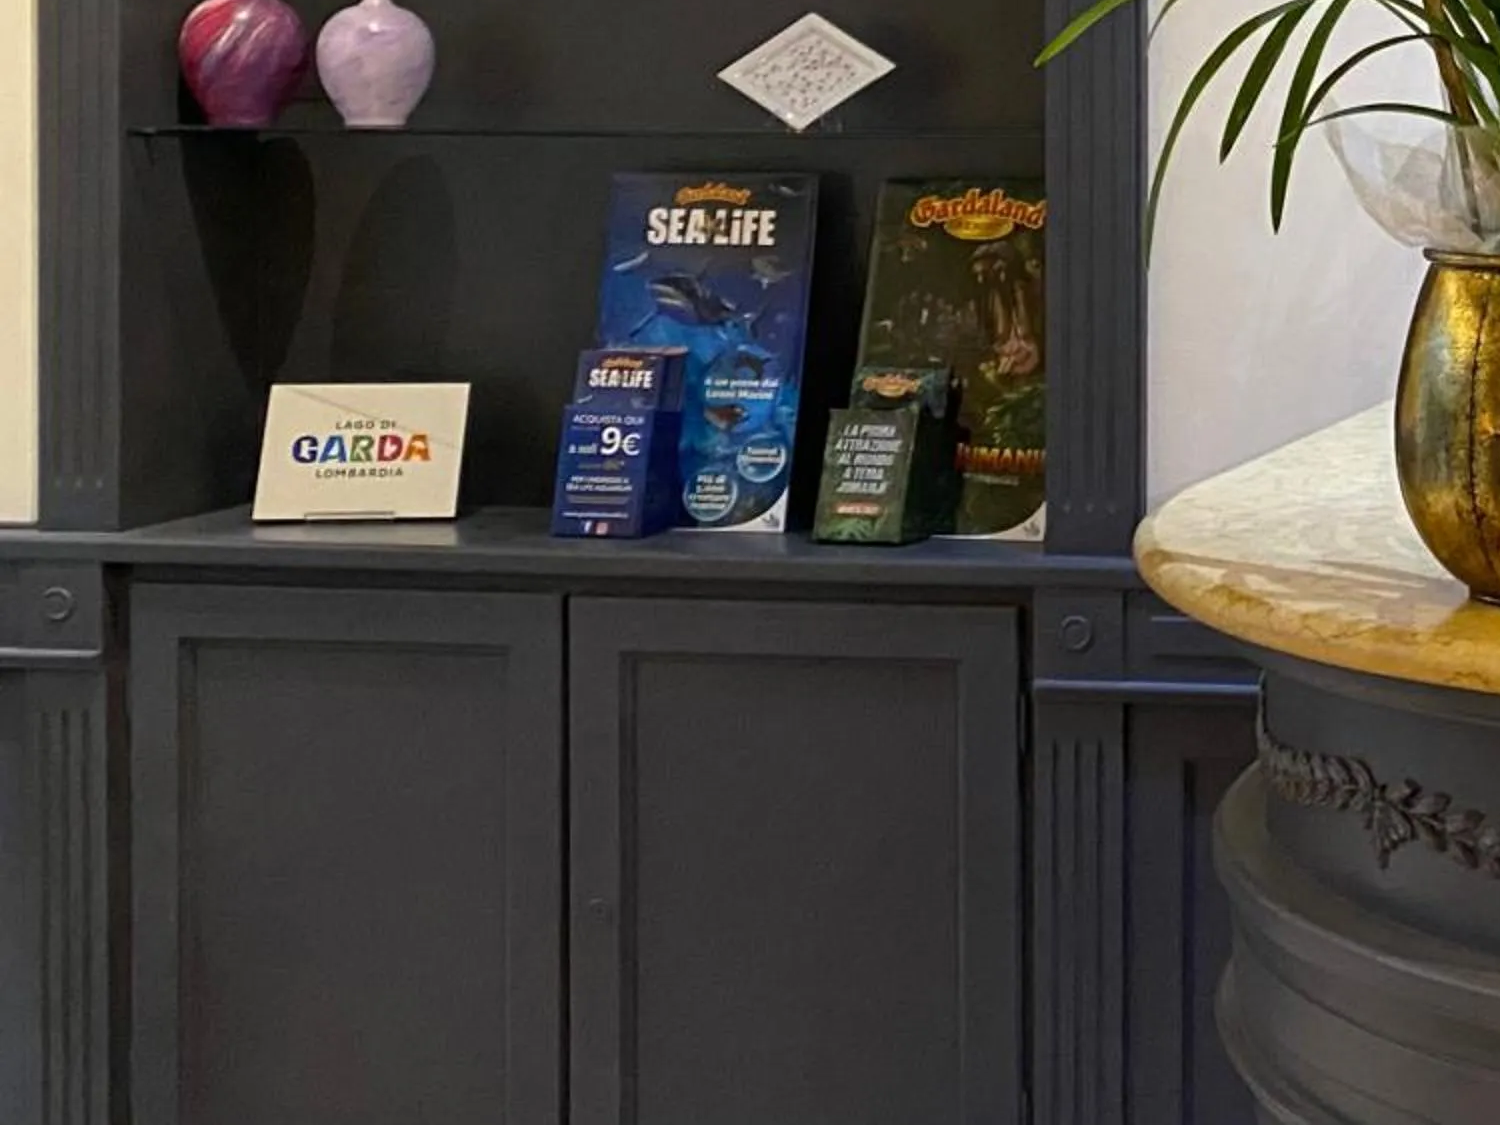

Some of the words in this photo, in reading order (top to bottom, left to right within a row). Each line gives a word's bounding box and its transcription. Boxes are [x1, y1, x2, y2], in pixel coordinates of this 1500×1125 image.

[910, 188, 1048, 230] Gardaland
[647, 207, 706, 245] SEA
[335, 421, 375, 430] LAGO
[379, 420, 396, 429] DI
[573, 414, 622, 425] ACQUISTA
[291, 434, 432, 464] GARDA
[601, 426, 642, 456] 9€
[315, 468, 404, 479] LOMBARDIA
